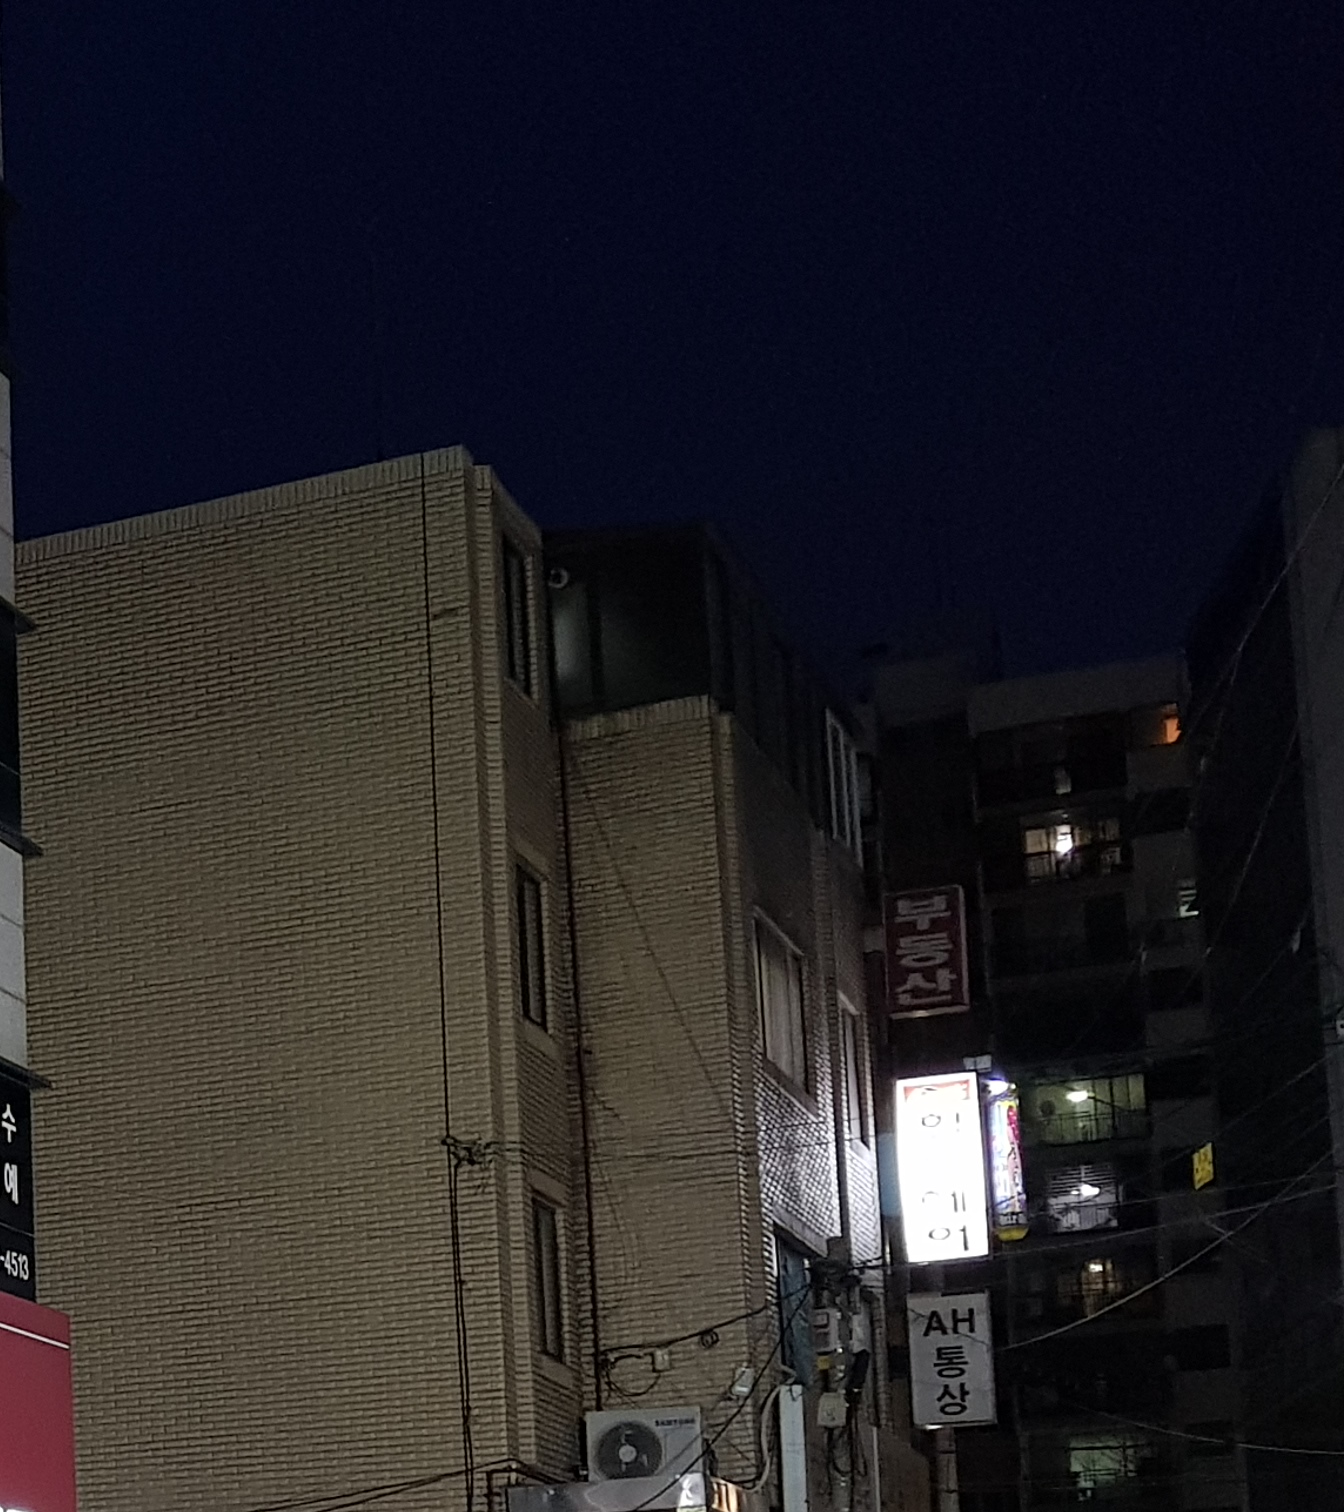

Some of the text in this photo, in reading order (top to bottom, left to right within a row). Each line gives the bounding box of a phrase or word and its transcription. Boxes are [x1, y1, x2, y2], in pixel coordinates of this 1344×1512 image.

[894, 894, 957, 1007] 부동산
[922, 1306, 976, 1338] AH
[932, 1344, 971, 1416] 통상
